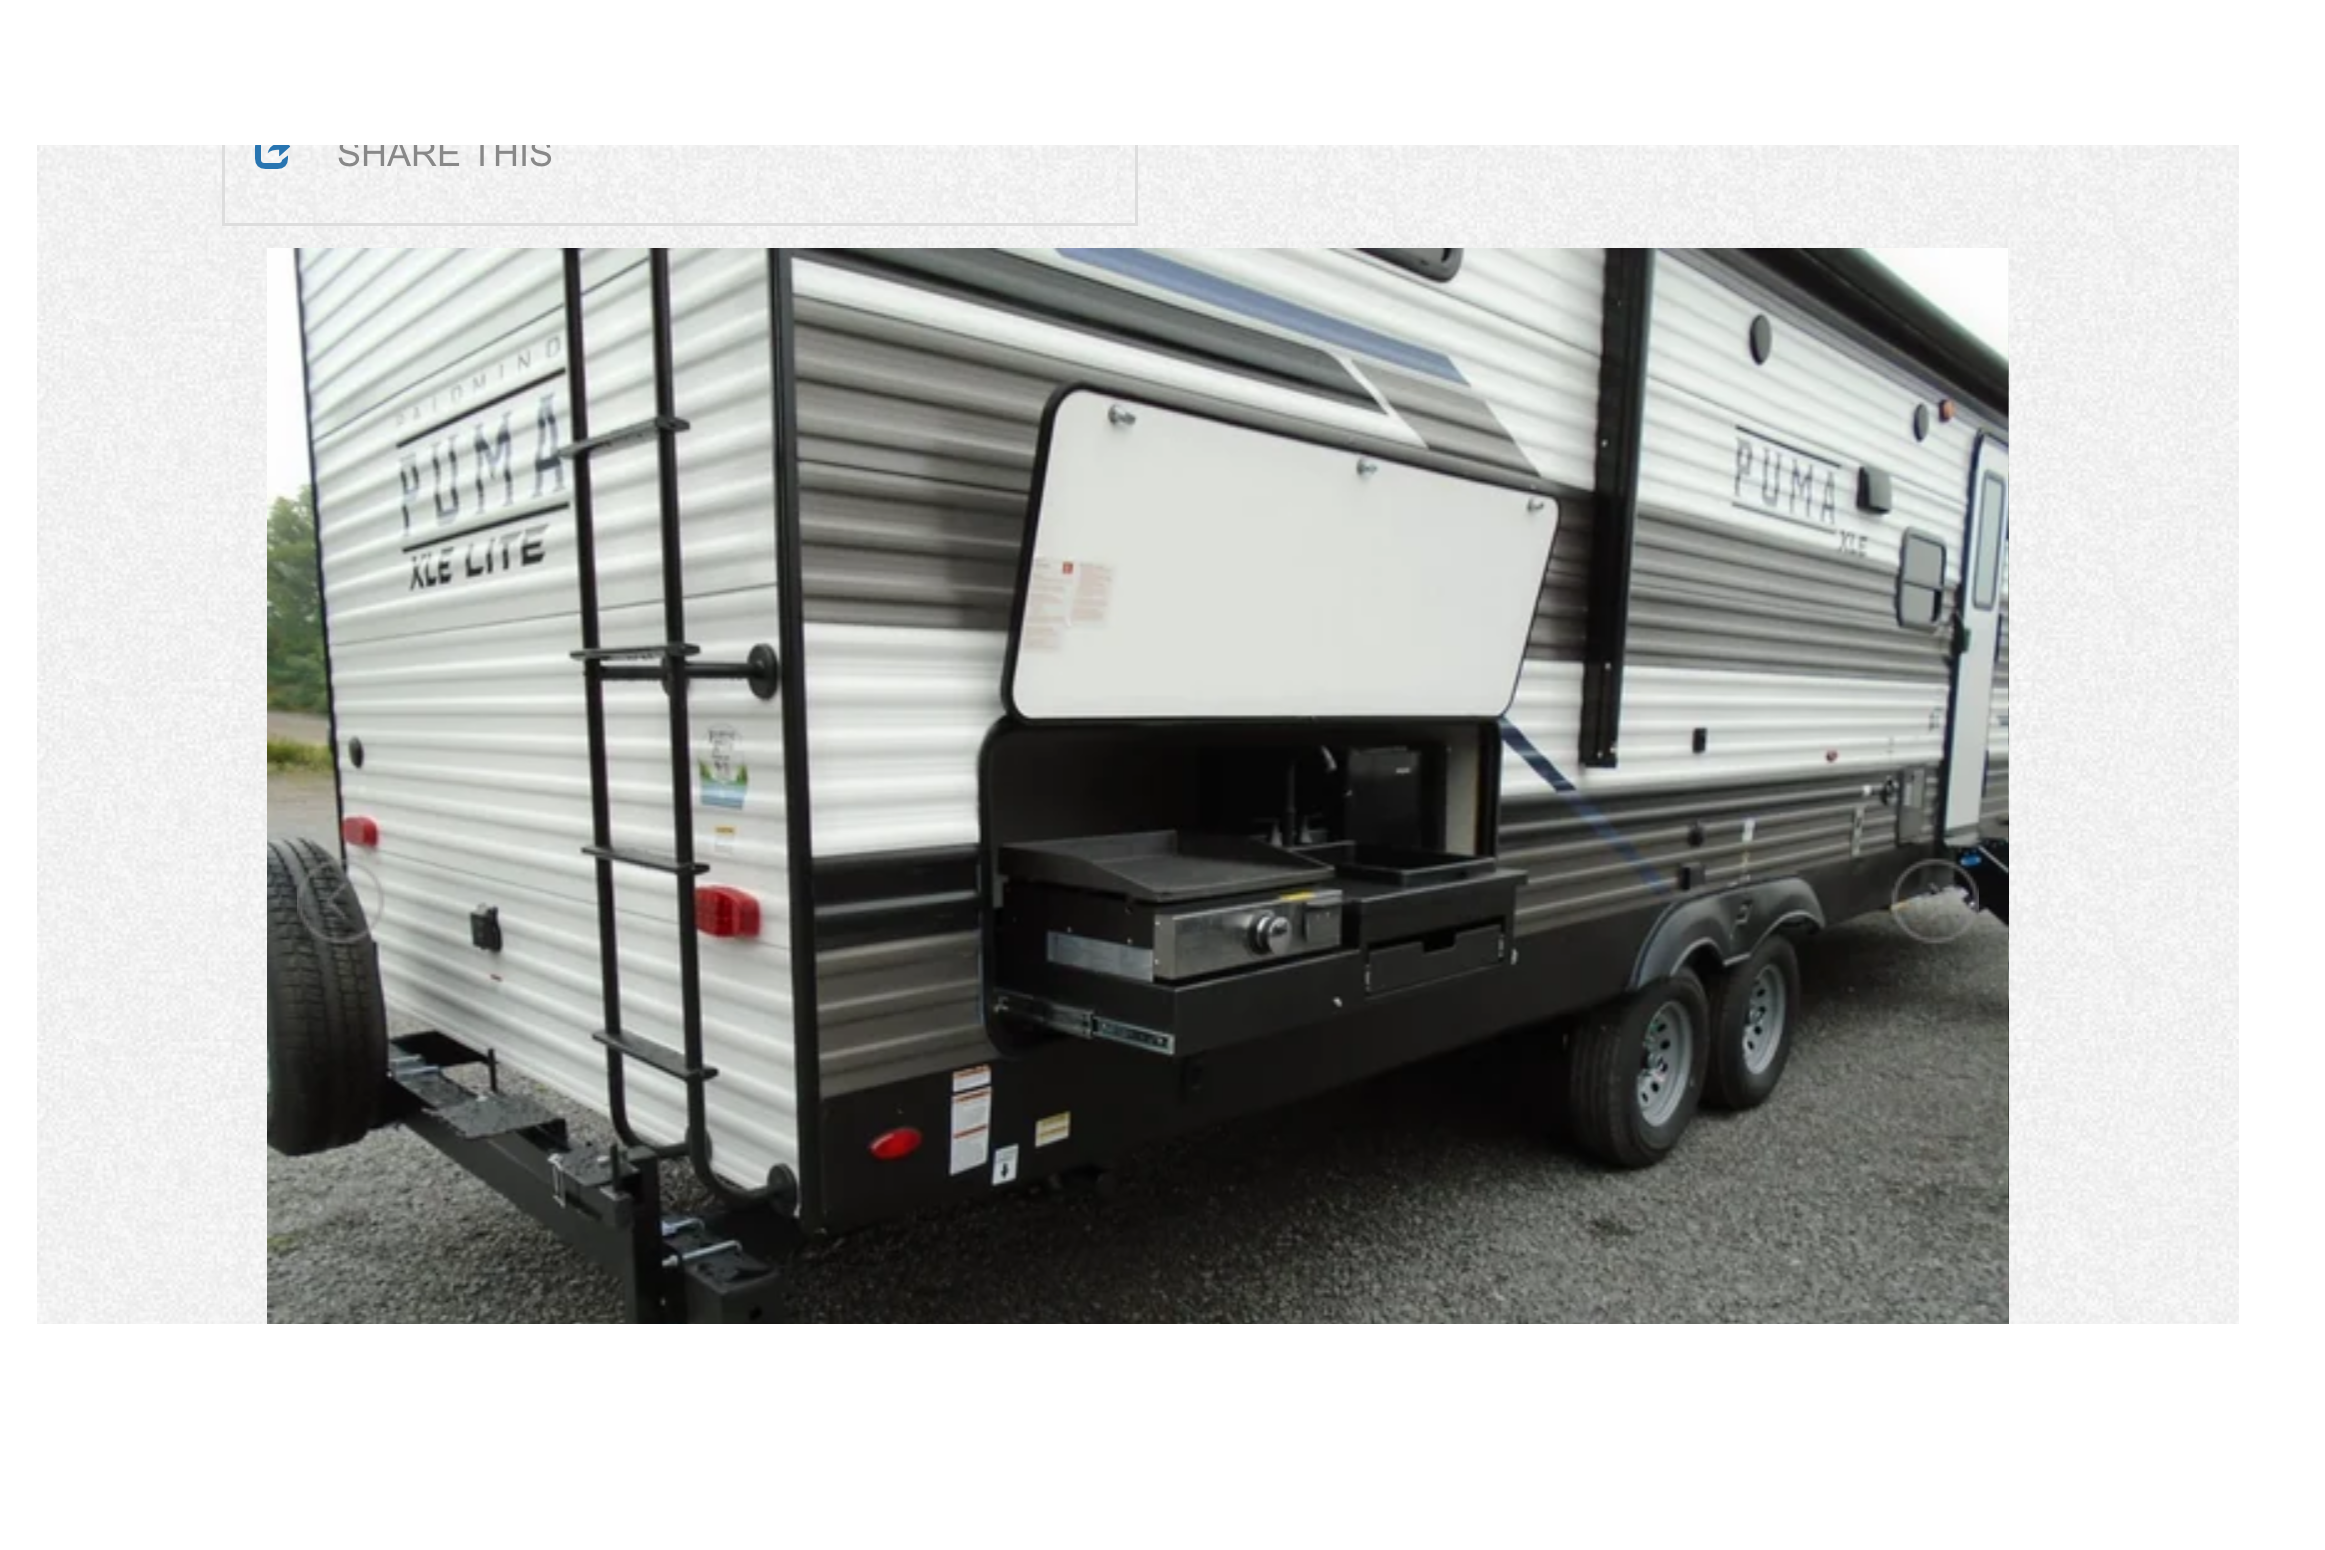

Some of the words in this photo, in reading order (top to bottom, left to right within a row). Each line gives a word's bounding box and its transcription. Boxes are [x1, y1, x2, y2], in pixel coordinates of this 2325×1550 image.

[399, 393, 567, 537] PUMA
[1734, 436, 1835, 525] PUMA
[409, 547, 454, 591] XLE
[465, 523, 549, 578] LITE
[1839, 529, 1868, 558] XLE
